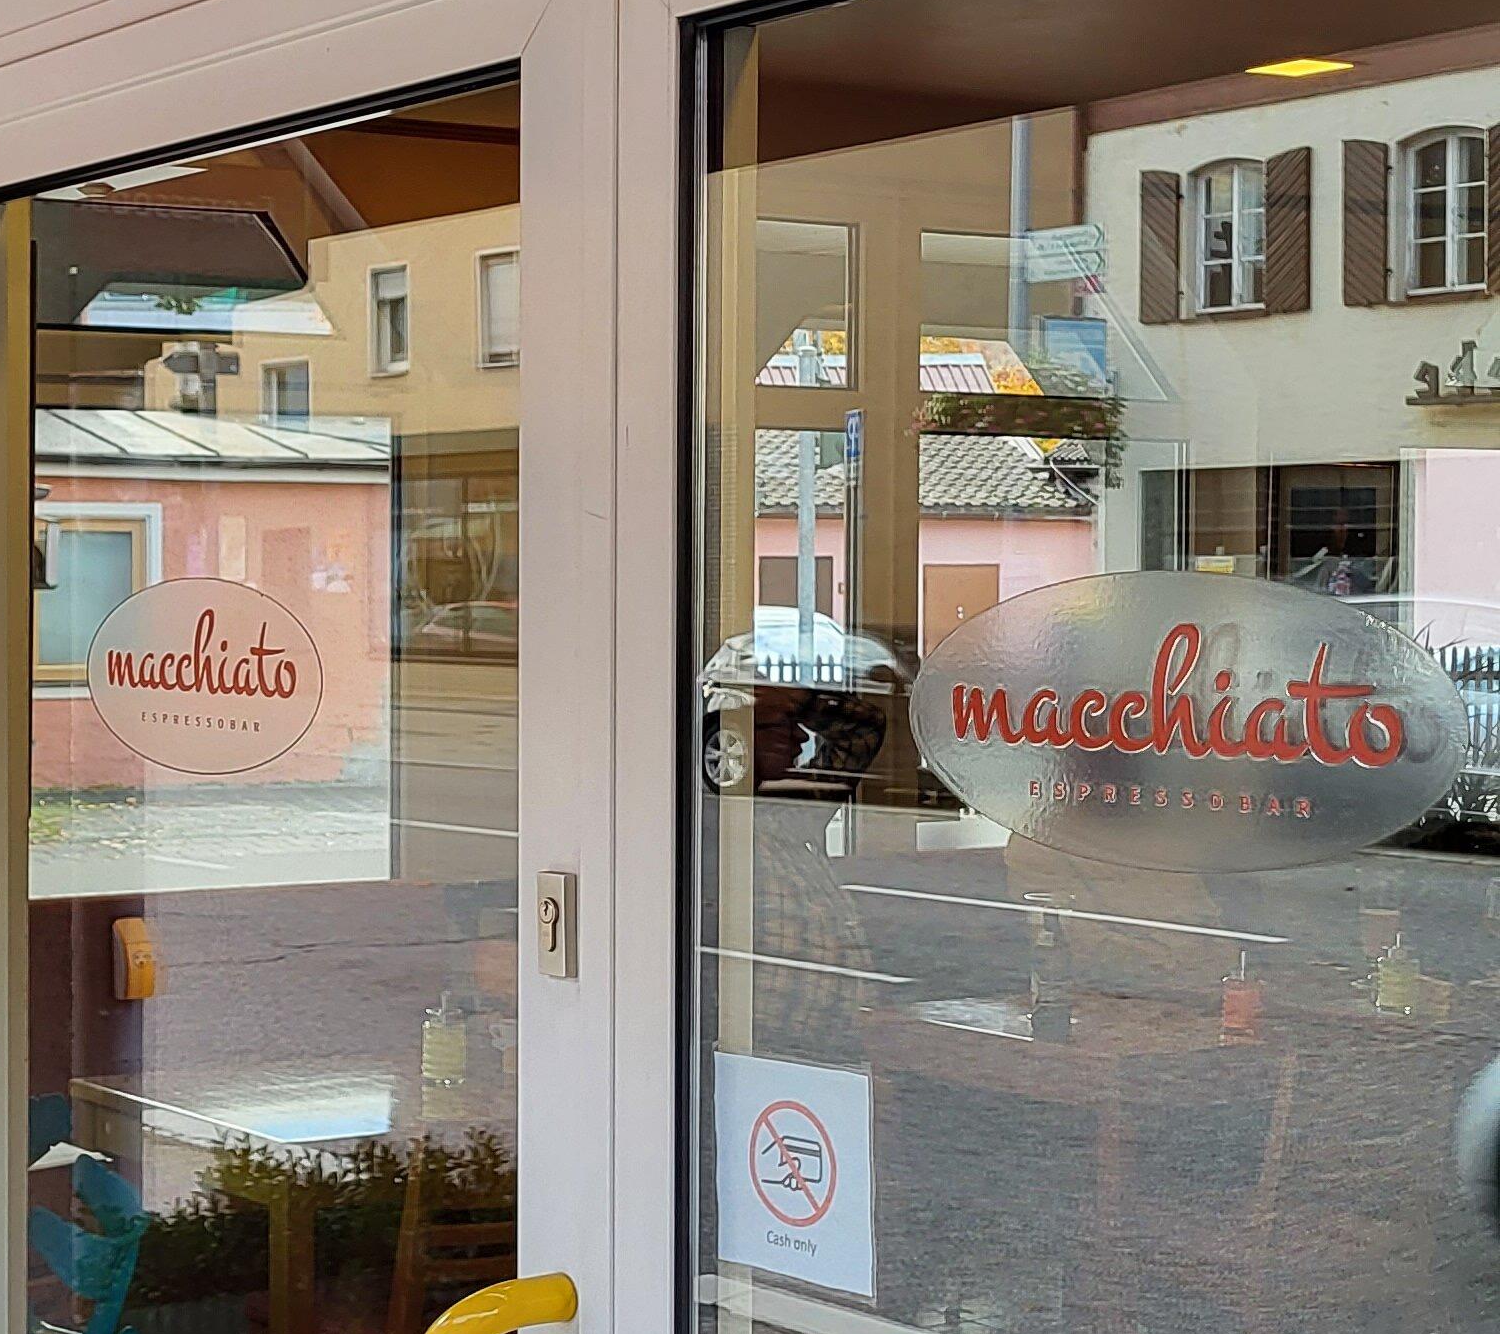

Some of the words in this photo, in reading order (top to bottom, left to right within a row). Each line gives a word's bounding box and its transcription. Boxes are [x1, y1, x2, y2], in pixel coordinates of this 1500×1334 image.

[107, 608, 297, 698] macchiato
[951, 623, 1406, 768] macchiato
[141, 711, 261, 733] ESPRESSOBAR
[1029, 780, 1311, 819] ESPRESSOBAR
[767, 1230, 791, 1247] Cash
[794, 1239, 817, 1257] only
